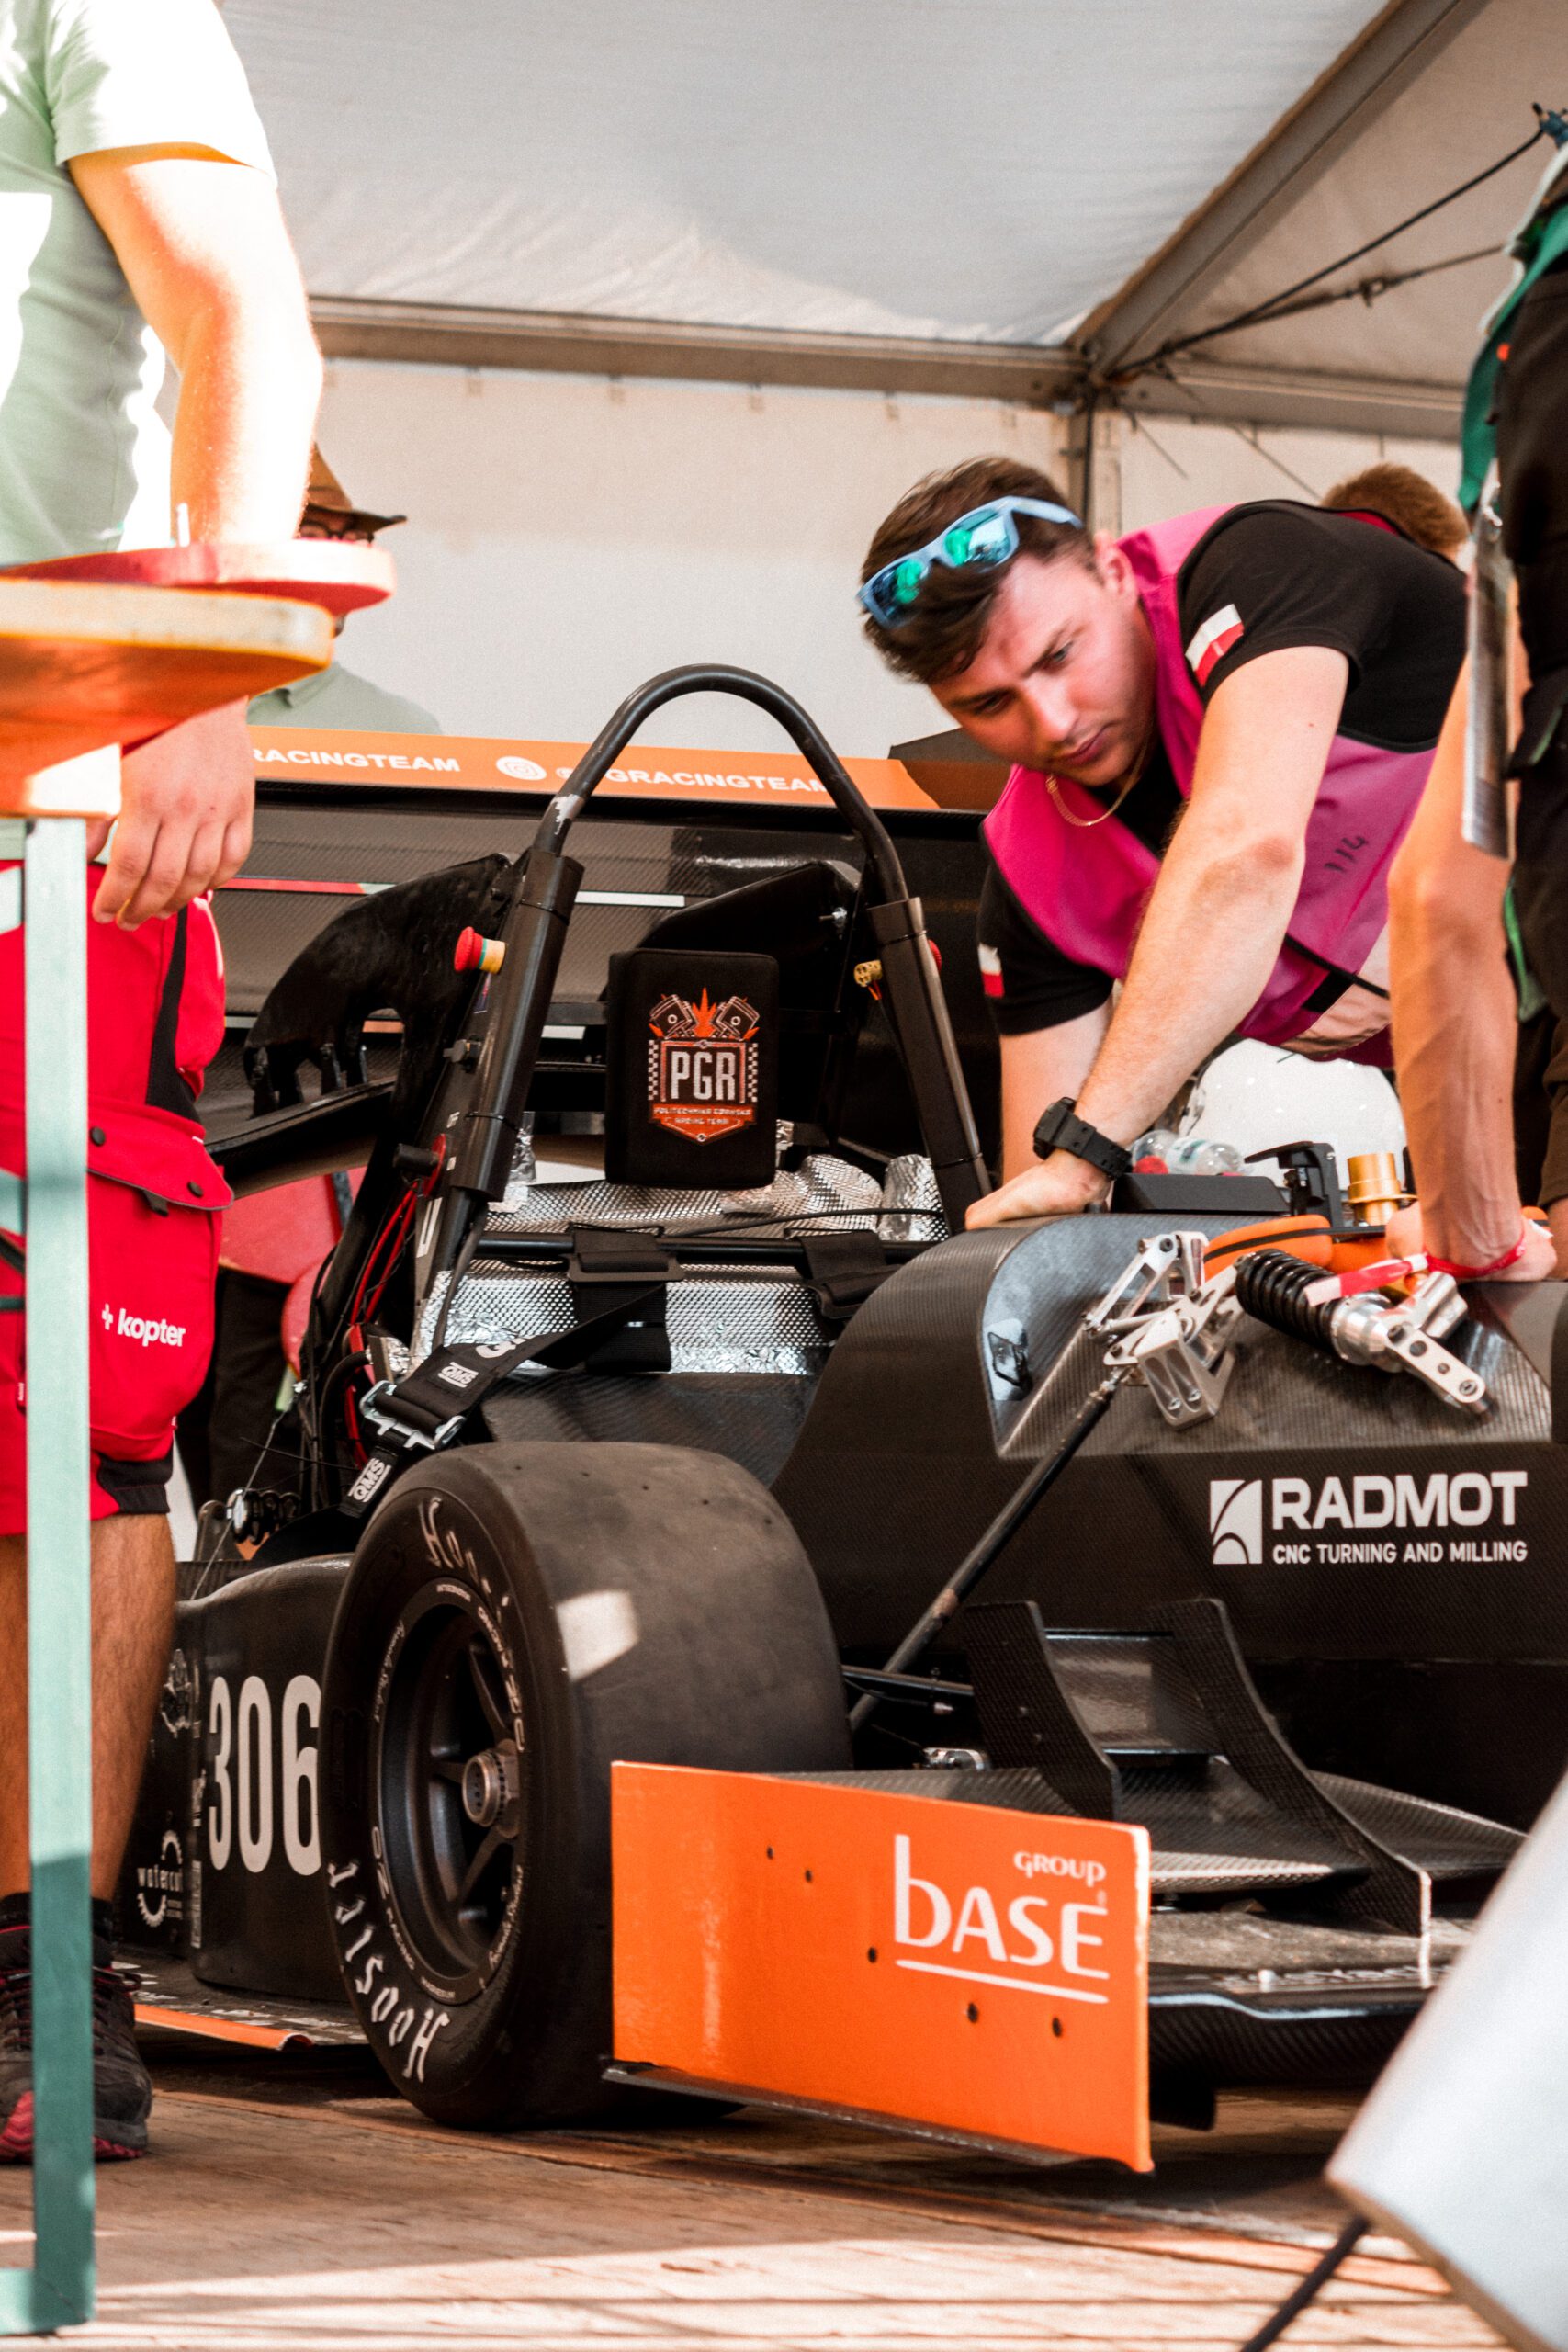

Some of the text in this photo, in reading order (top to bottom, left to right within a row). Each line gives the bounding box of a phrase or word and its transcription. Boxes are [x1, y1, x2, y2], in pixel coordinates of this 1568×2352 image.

[671, 1051, 736, 1101] PGR
[117, 1307, 186, 1347] kopter
[1271, 1470, 1528, 1530] RADMOT
[1272, 1539, 1528, 1564] CNC TURNING AND MILLING
[209, 1674, 321, 1875] 306
